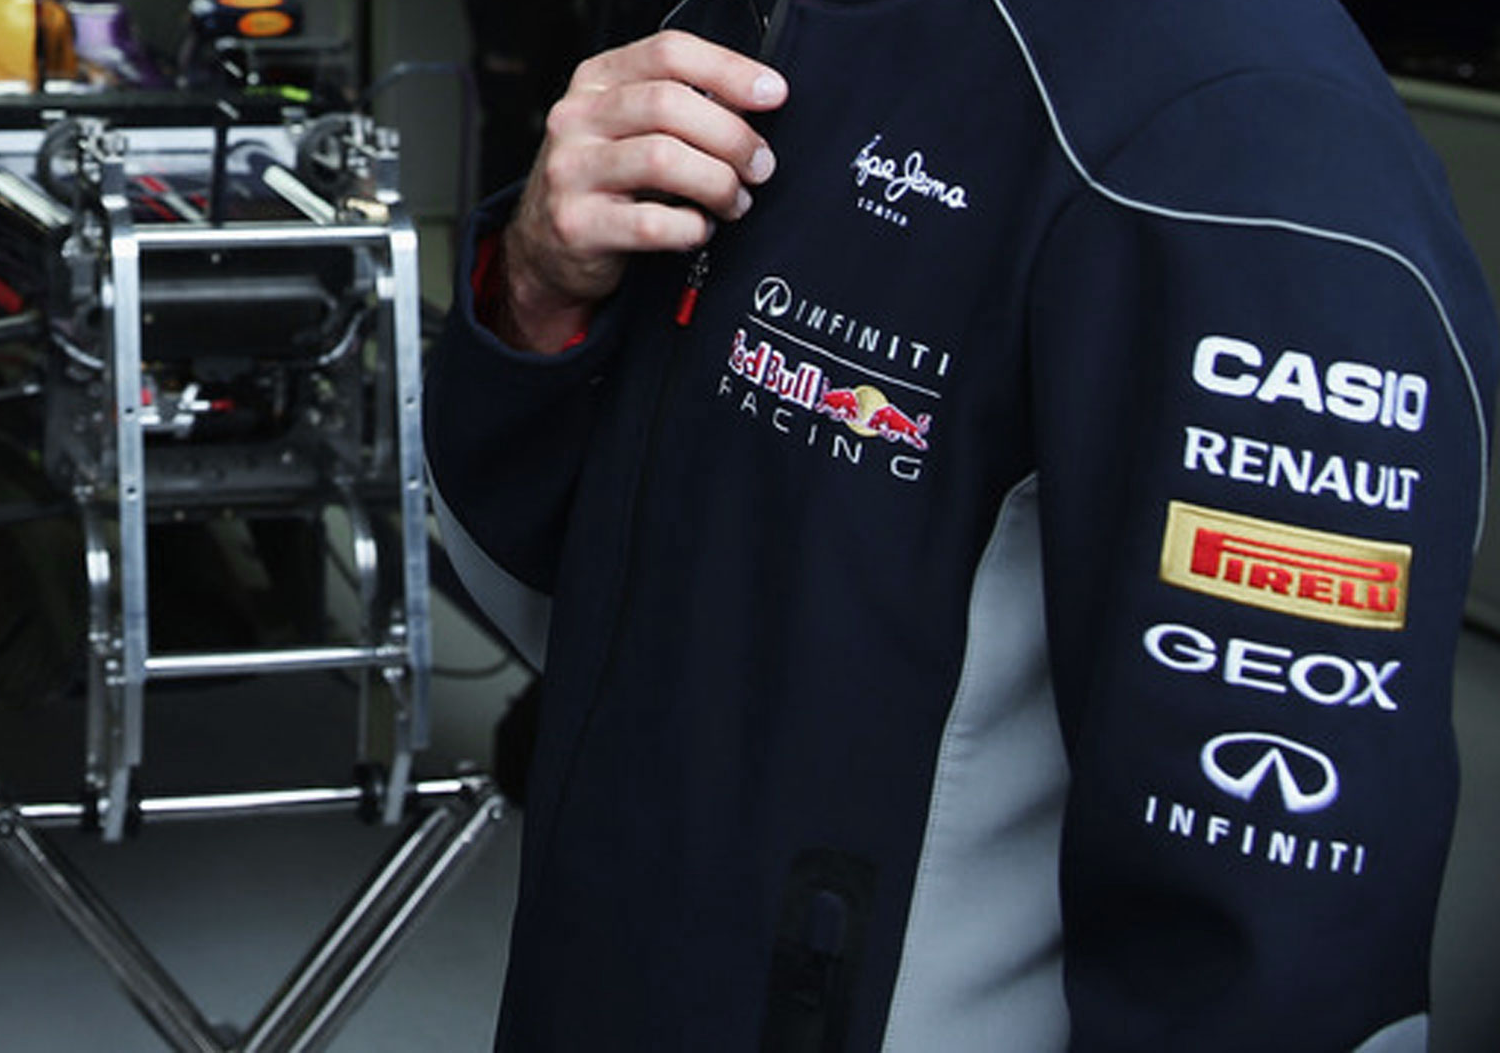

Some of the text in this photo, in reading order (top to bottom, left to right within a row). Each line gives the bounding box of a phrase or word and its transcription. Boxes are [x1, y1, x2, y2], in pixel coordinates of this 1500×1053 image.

[796, 300, 950, 376] INFINITI
[1192, 335, 1428, 432] CASIO
[718, 376, 923, 481] RACING
[1183, 426, 1421, 511] RENAULT
[1190, 527, 1400, 613] PIRELLI
[1143, 623, 1400, 711] GEOX
[1145, 796, 1367, 875] INFINITI
